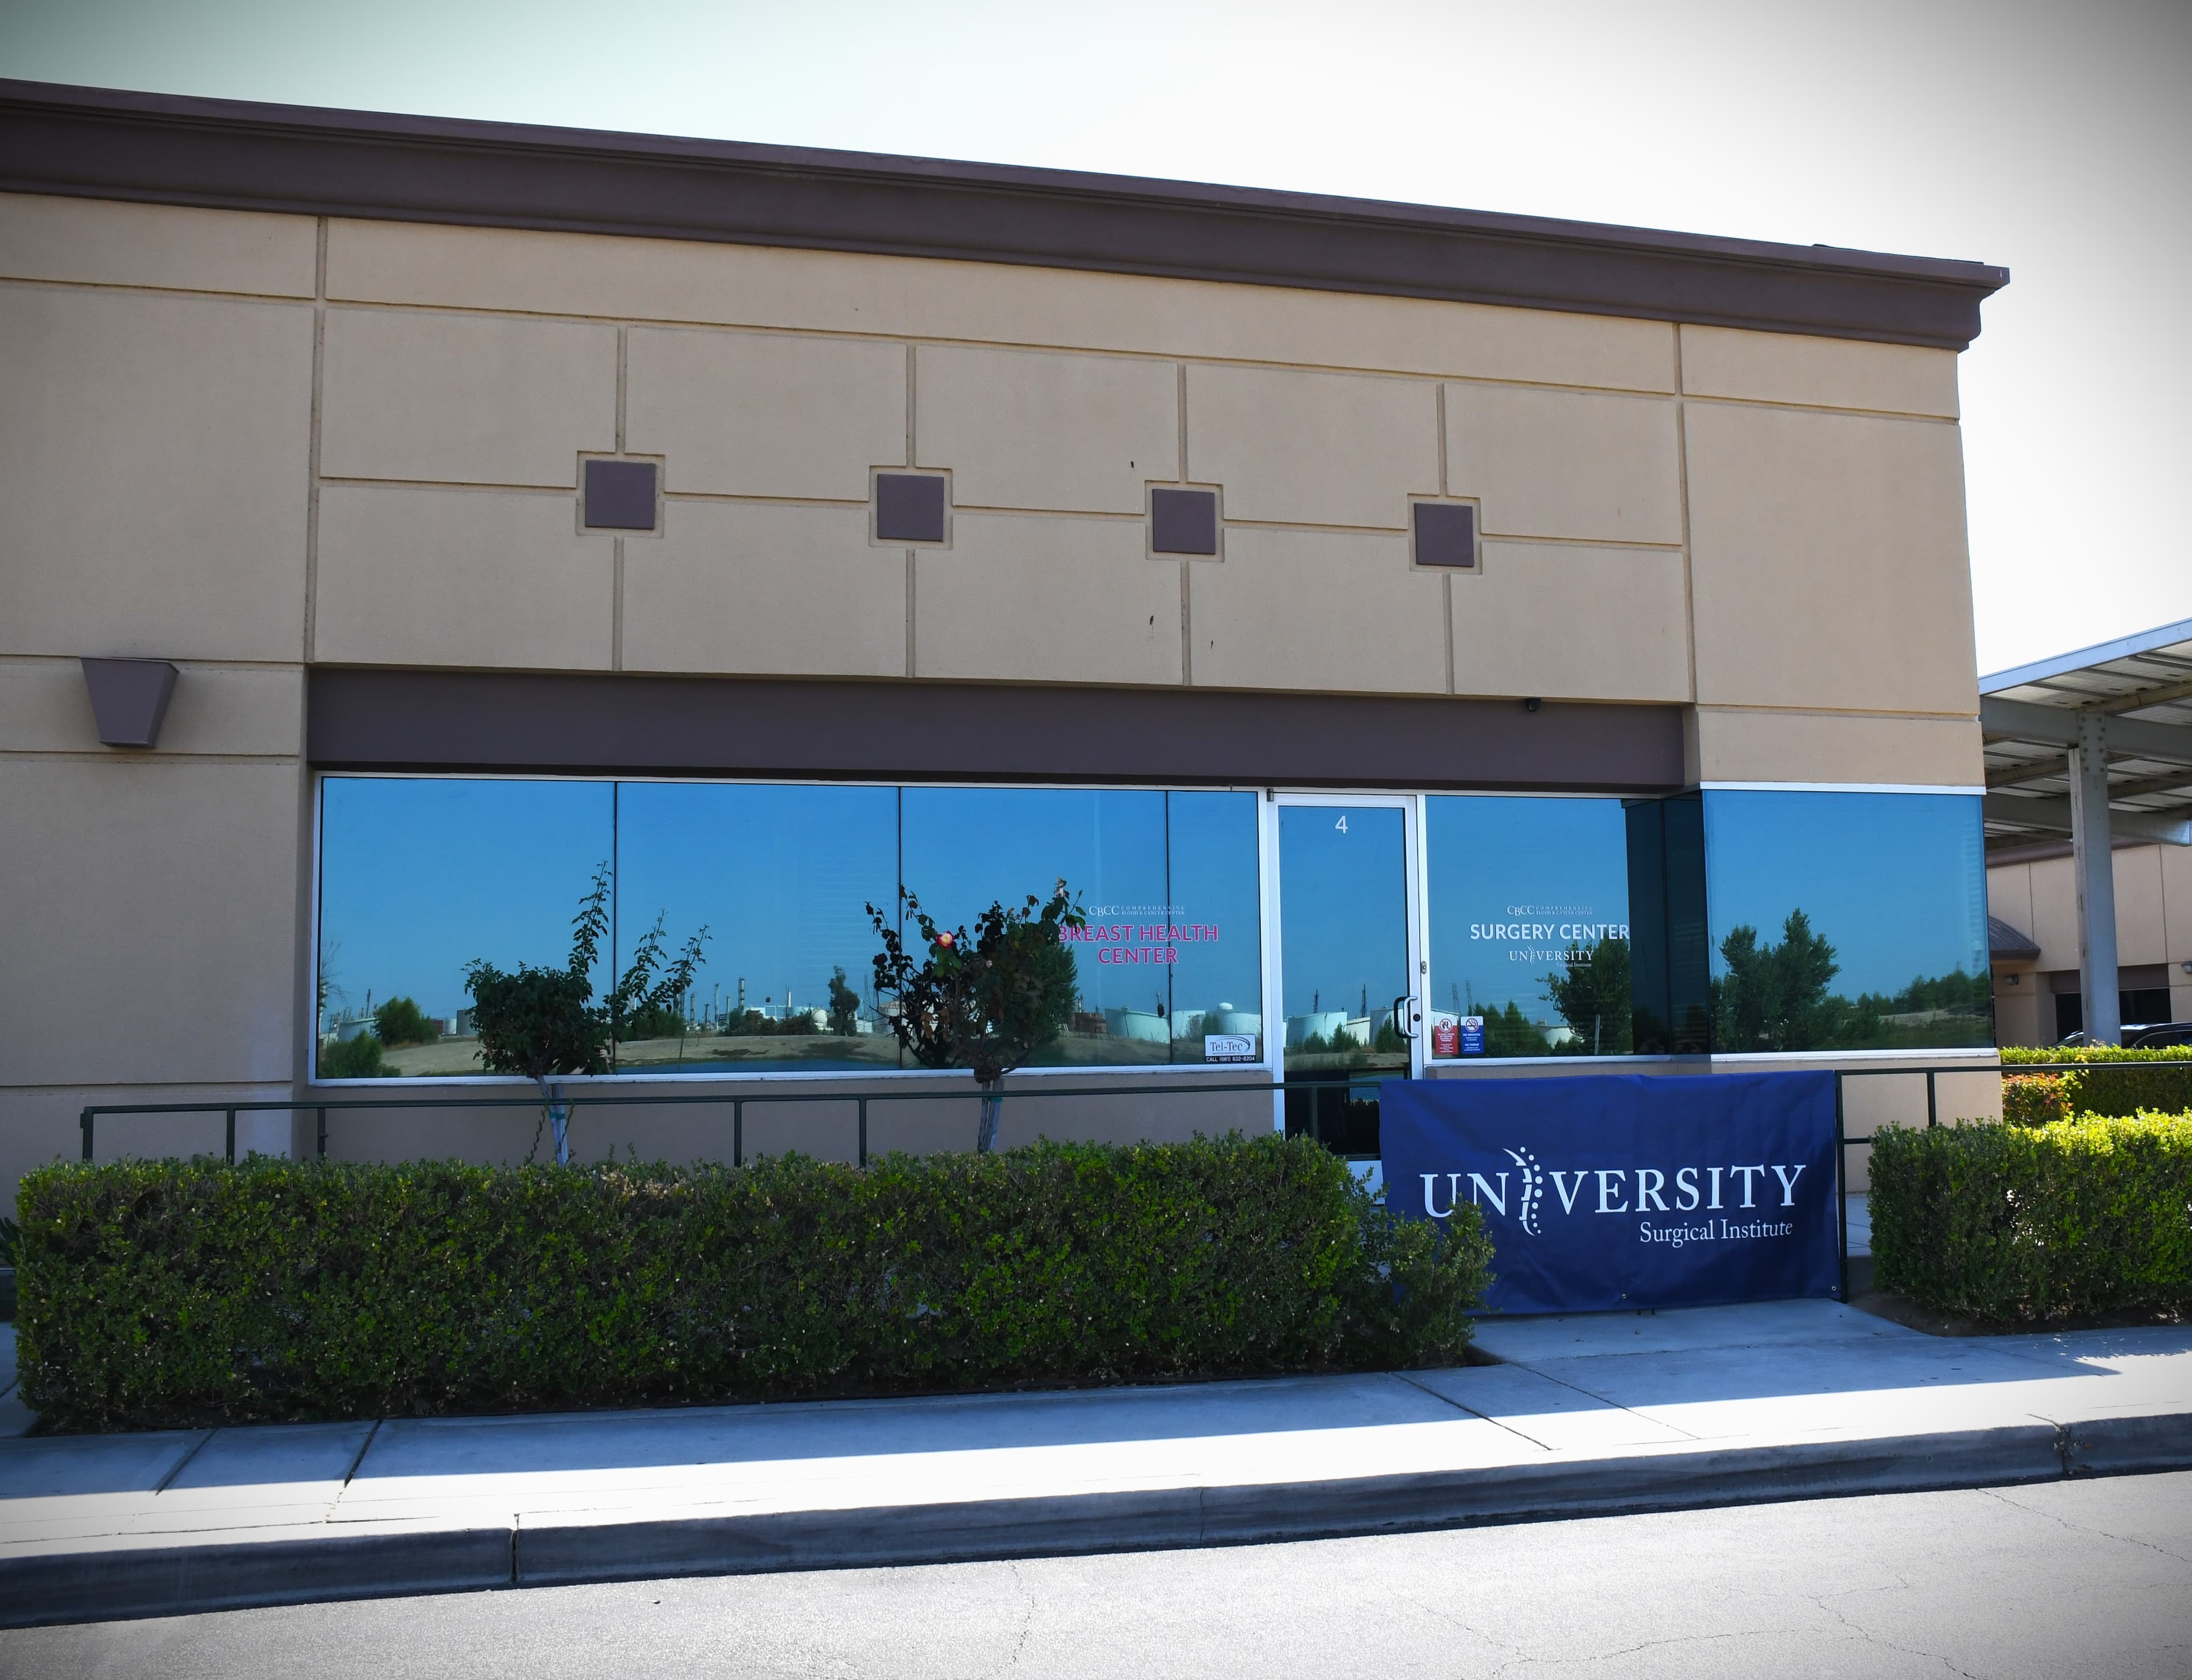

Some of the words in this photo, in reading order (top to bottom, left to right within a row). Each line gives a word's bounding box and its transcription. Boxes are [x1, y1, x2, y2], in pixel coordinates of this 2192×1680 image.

[1335, 815, 1348, 833] 4
[1089, 905, 1119, 916] CBCC
[1506, 905, 1534, 916] CBCC
[1059, 924, 1134, 942] BREAST
[1139, 924, 1218, 942] HEALTH
[1470, 923, 1555, 940] SURGERY
[1559, 923, 1630, 940] CENTER
[1097, 946, 1179, 964] CENTER
[1210, 1041, 1243, 1051] Tel-Tec
[1420, 1148, 1806, 1235] UNIVERSITY
[1639, 1219, 1715, 1248] Surgical
[1720, 1219, 1793, 1239] Institute
